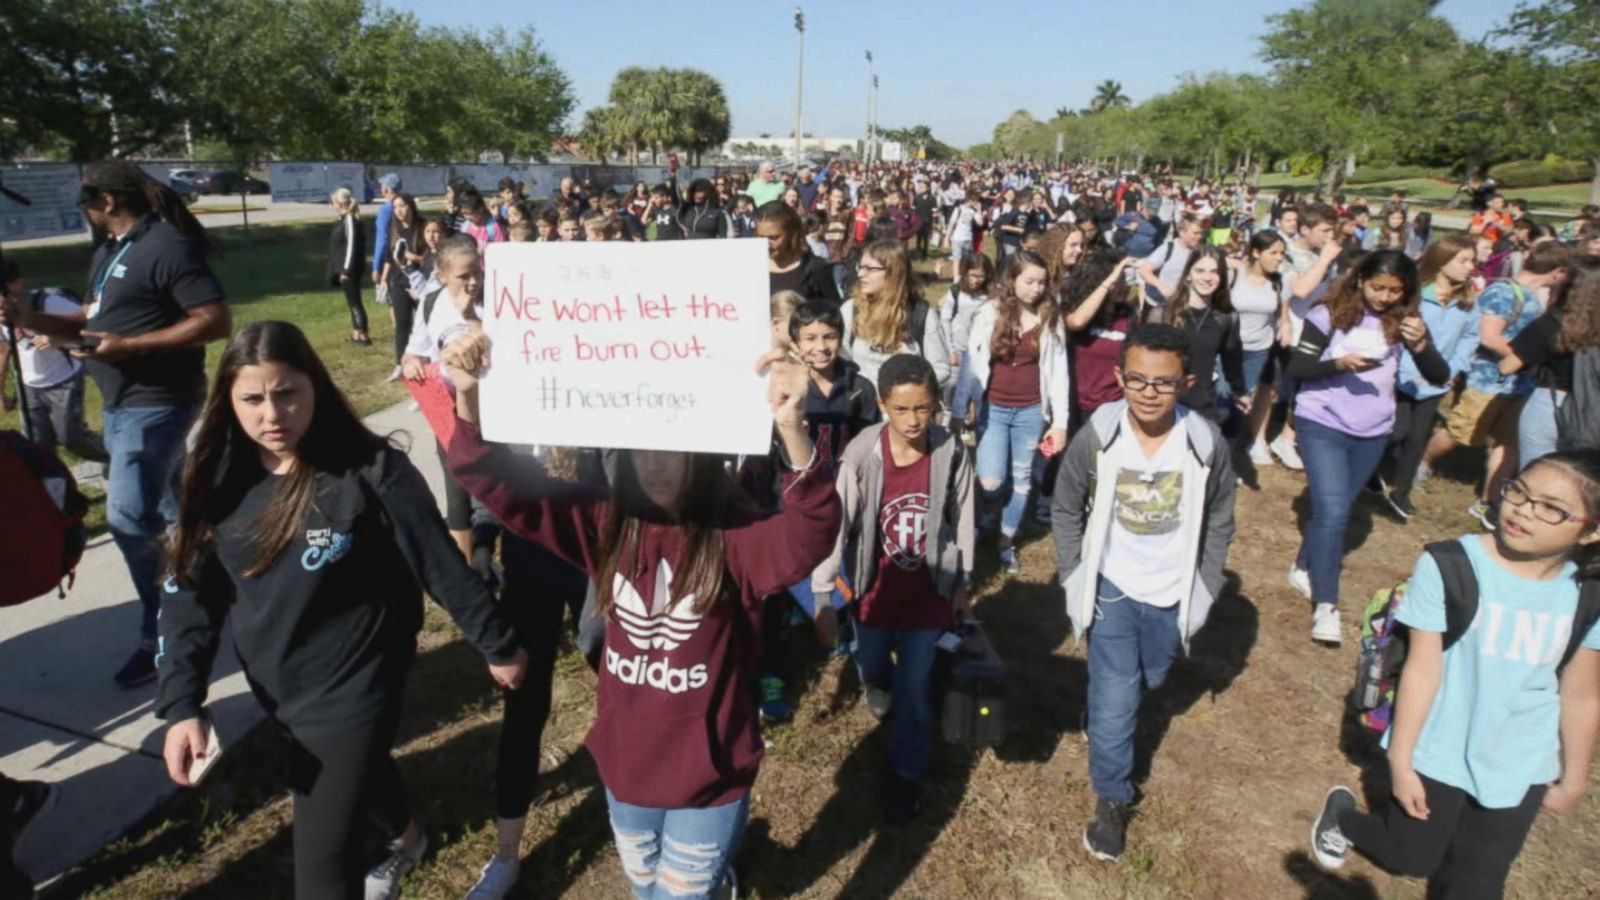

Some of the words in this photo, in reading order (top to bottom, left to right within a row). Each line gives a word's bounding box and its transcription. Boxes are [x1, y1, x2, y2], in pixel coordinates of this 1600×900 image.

[492, 268, 541, 321] We
[552, 295, 627, 322] wont
[637, 293, 677, 318] let
[686, 294, 739, 321] the
[520, 330, 562, 363] fire
[575, 335, 638, 361] burn
[650, 335, 711, 361] out.
[536, 376, 697, 424] #neverforget
[606, 646, 709, 694] adidas
